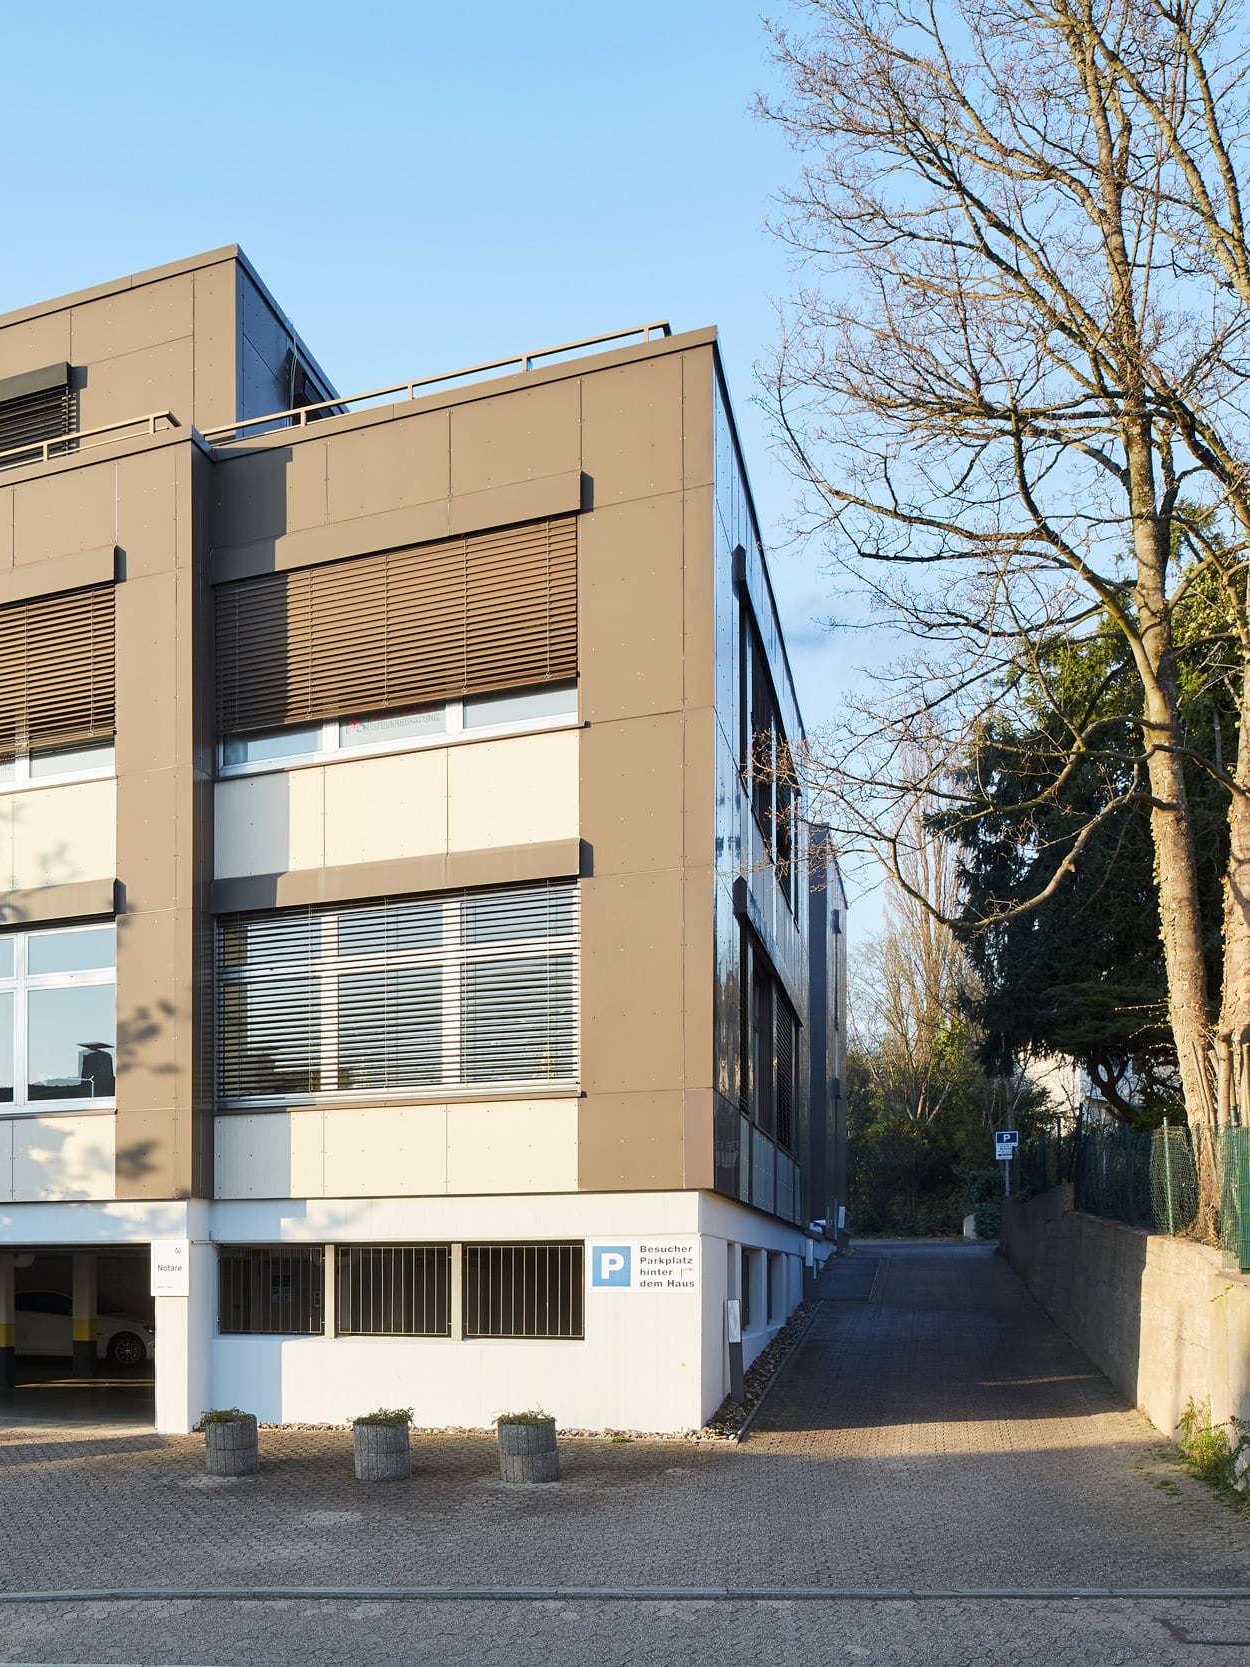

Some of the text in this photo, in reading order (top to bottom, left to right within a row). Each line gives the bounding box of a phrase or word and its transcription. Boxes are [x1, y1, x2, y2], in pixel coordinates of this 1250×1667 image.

[1003, 1134, 1011, 1143] P
[640, 1245, 693, 1253] Besucher
[640, 1256, 693, 1266] Parkplatz
[157, 1264, 183, 1272] Notare
[601, 1252, 625, 1280] P
[640, 1268, 673, 1276] hinter
[640, 1280, 695, 1288] dem Haus
